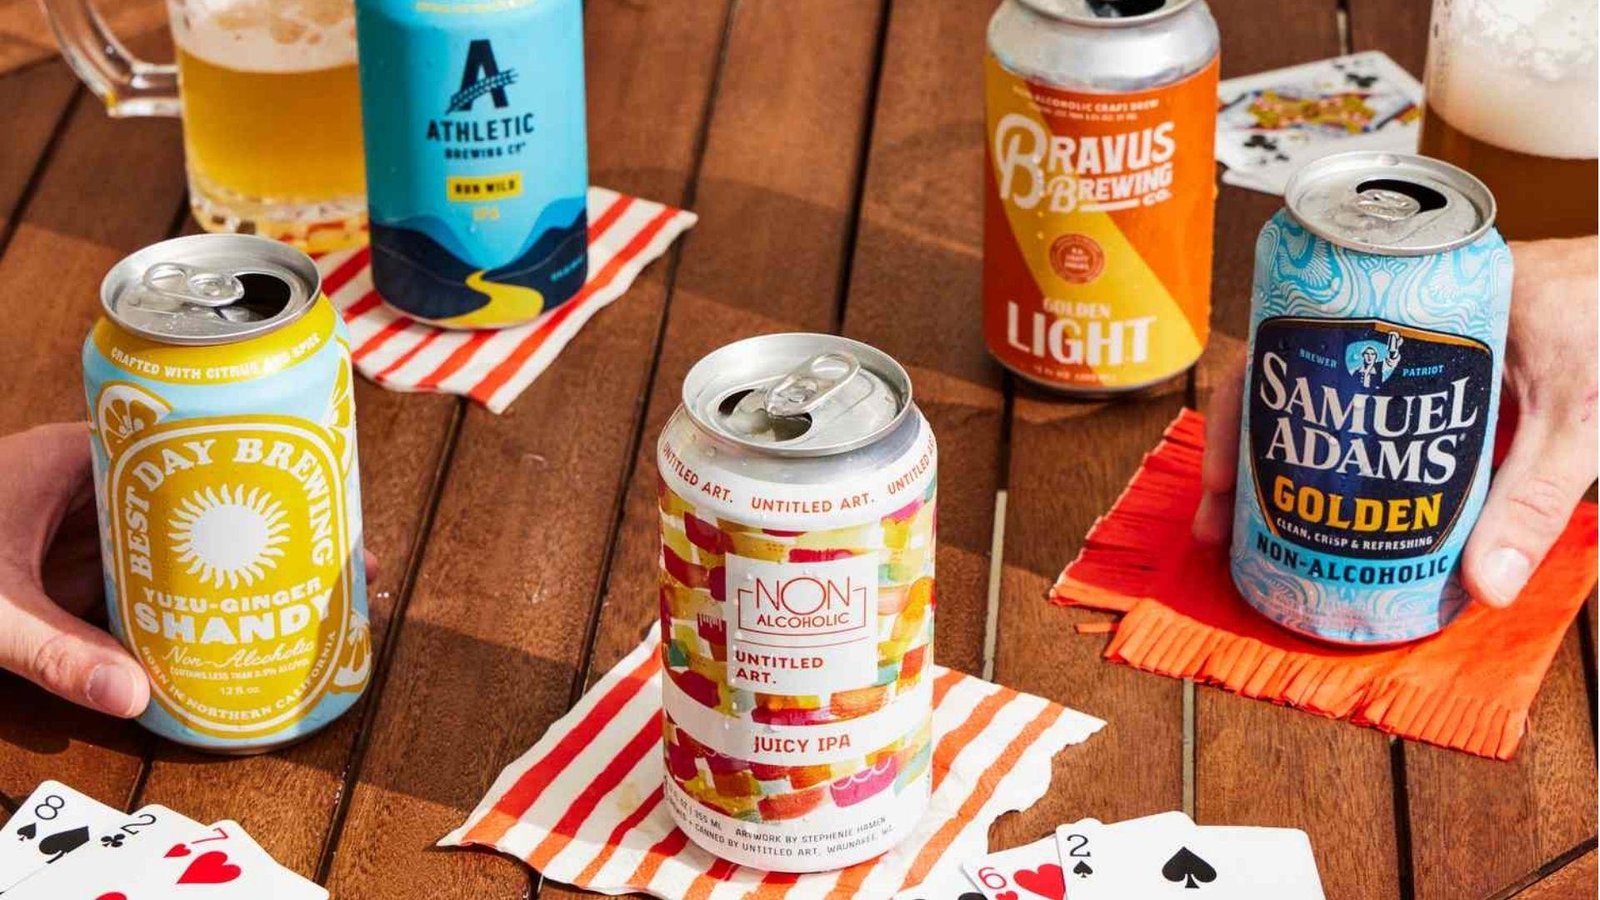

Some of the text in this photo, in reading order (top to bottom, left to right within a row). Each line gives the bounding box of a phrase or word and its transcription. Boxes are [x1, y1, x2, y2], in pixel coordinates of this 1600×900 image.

[1094, 100, 1128, 112] CRAFT
[427, 113, 534, 142] ATHLETIC
[445, 147, 502, 159] BREWING
[995, 113, 1176, 209] BRAVUS
[455, 180, 515, 194] RUN WILD
[1049, 162, 1173, 213] BREWING
[1042, 297, 1111, 318] GOLDEN
[1008, 300, 1157, 366] LIGHT
[111, 346, 159, 375] CRAFTED
[165, 365, 201, 380] WITH
[206, 364, 258, 380] CITRUS
[1300, 348, 1444, 377] BREWER PATRIOT
[1260, 352, 1478, 438] SAMUEL
[888, 453, 930, 495] UNTITLED
[701, 480, 733, 504] ART.
[751, 491, 875, 514] UNTITLED ART.
[1273, 475, 1444, 533] GOLDEN
[125, 437, 334, 582] BEST DAY BREWING
[1276, 517, 1312, 541] CLEAN,
[1351, 539, 1360, 549] &
[1362, 535, 1433, 551] REFRESHING
[1256, 532, 1450, 586] NON-ALCOHOLIC
[142, 577, 321, 614] YUZU-GINGER
[756, 576, 851, 616] NON
[133, 588, 333, 645] SHANDY
[756, 612, 850, 629] ALCOHOLIC
[161, 638, 316, 670] Non-Alcoholic
[735, 650, 824, 669] UNTITLED
[141, 630, 338, 722] BORN IN NORTHERN CALIFORNIA
[735, 668, 777, 684] ART.
[220, 686, 233, 696] 12
[754, 733, 851, 753] JUICY IPA
[35, 795, 65, 820] 8
[121, 813, 156, 835] 2
[191, 827, 229, 844] 7
[735, 827, 782, 844] ARTWORK
[785, 836, 798, 844] BY
[801, 827, 854, 844] STEPHENIE
[695, 823, 726, 844] CANNED
[727, 838, 740, 848] BY
[742, 843, 793, 857] UNTITLED
[1066, 834, 1091, 857] 2
[978, 866, 1006, 889] 6
